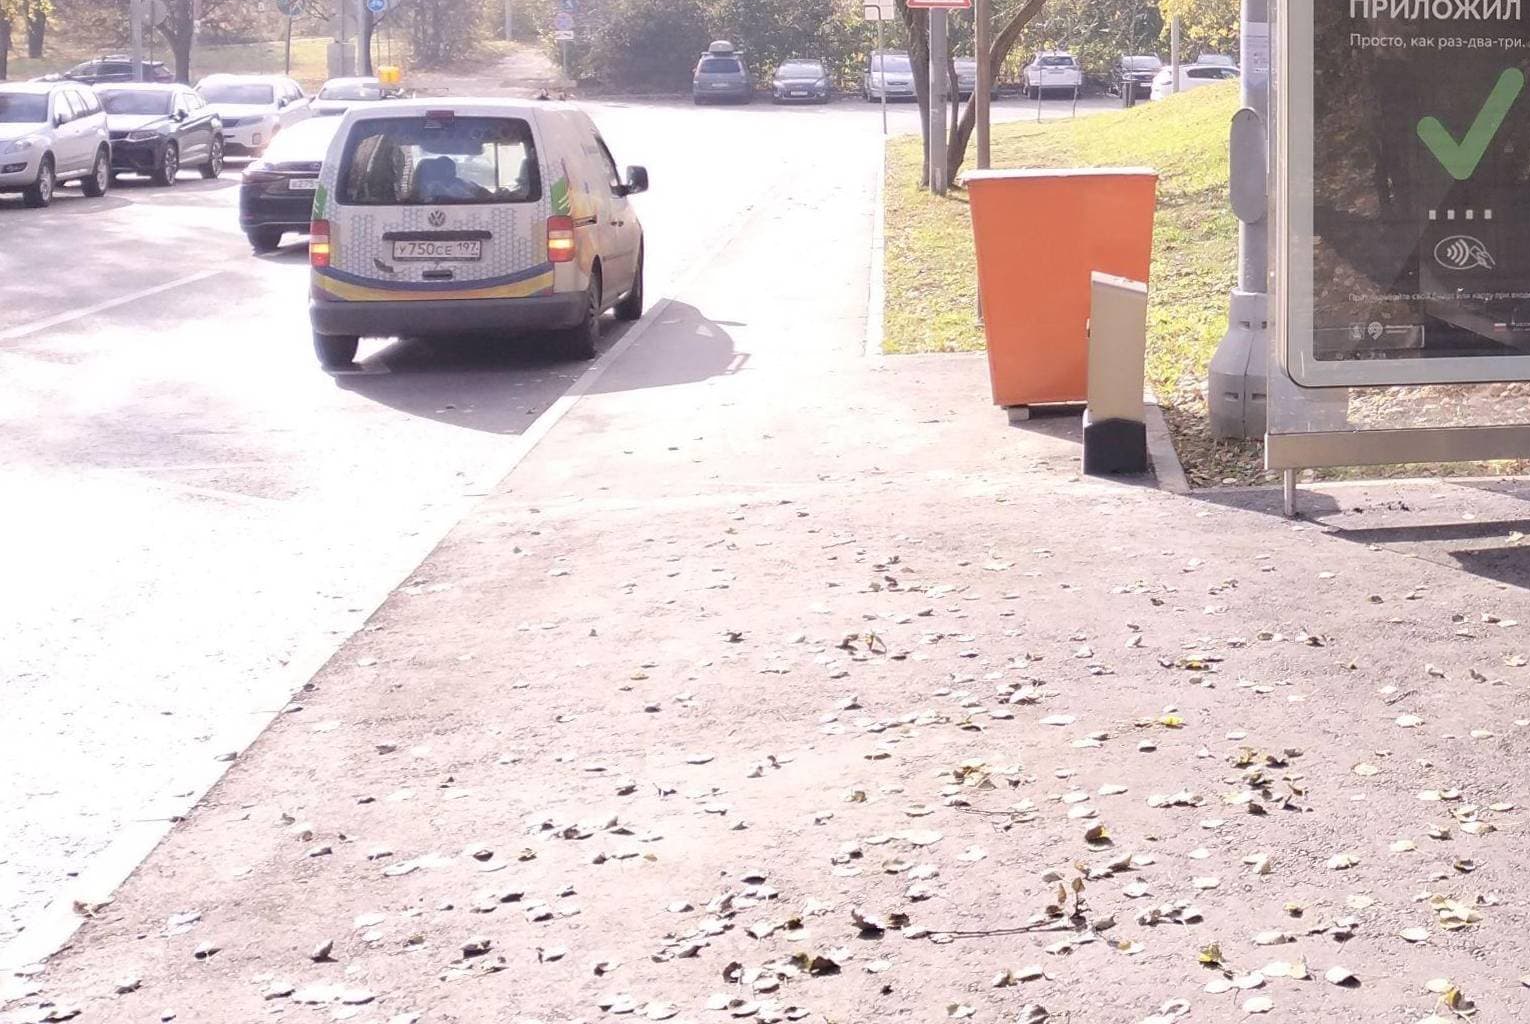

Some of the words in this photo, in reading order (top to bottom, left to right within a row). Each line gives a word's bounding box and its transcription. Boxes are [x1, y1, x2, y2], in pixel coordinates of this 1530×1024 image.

[1349, 33, 1407, 49] Просто,
[1410, 36, 1434, 47] как
[1438, 36, 1526, 49] раз-два-три.
